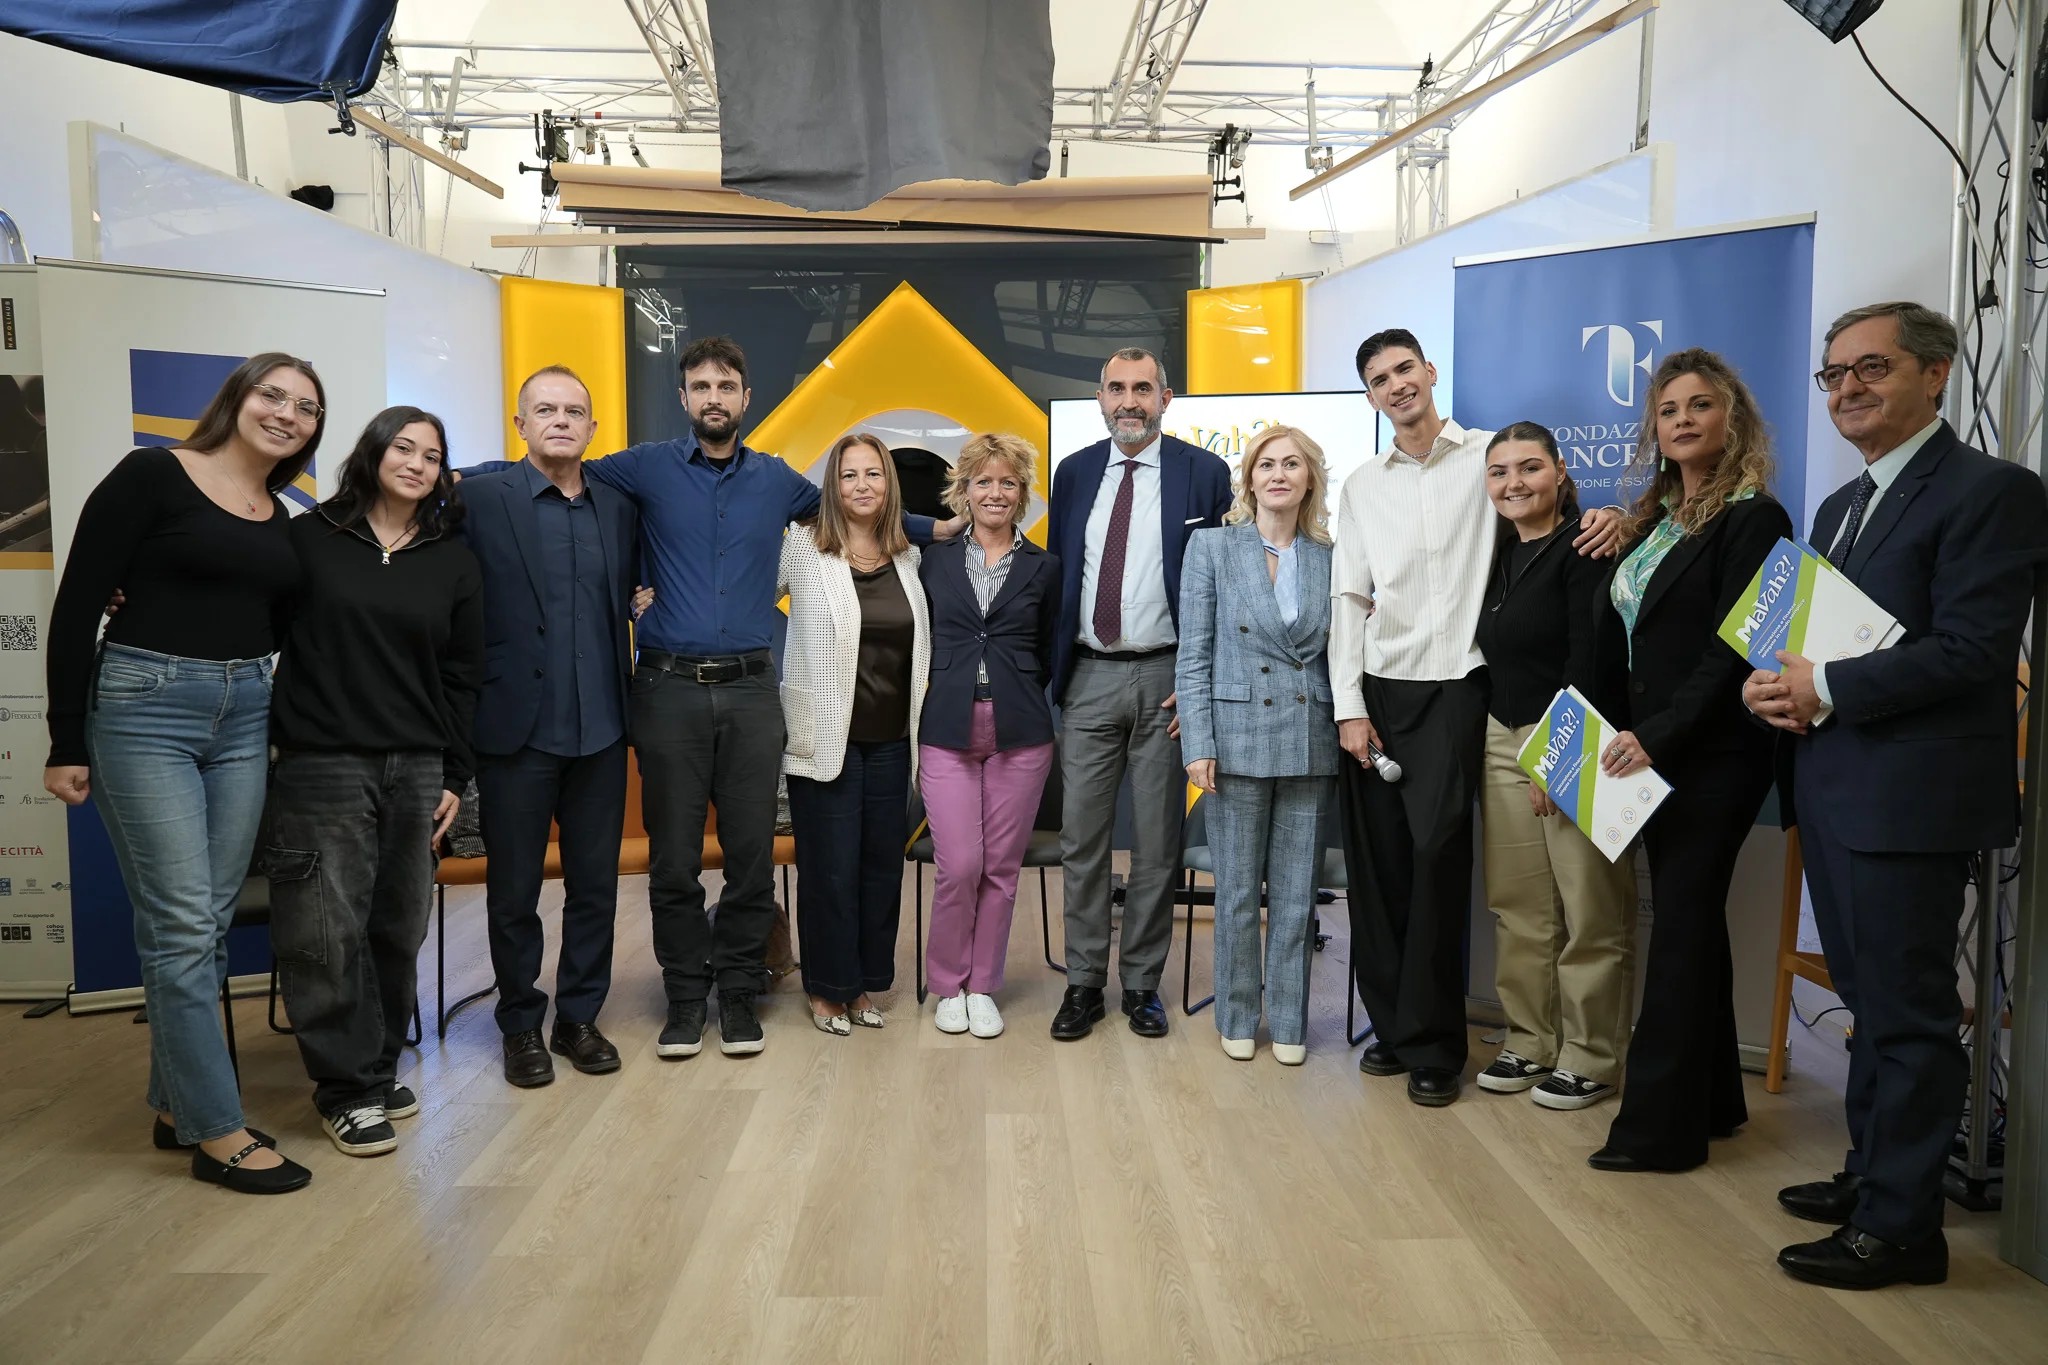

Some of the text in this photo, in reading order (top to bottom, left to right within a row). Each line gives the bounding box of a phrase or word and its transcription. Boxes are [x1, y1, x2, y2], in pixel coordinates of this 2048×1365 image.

[5, 301, 13, 348] NAPOLIHUB
[1735, 554, 1795, 644] MaVah?!
[1533, 708, 1581, 780] MaVah?!
